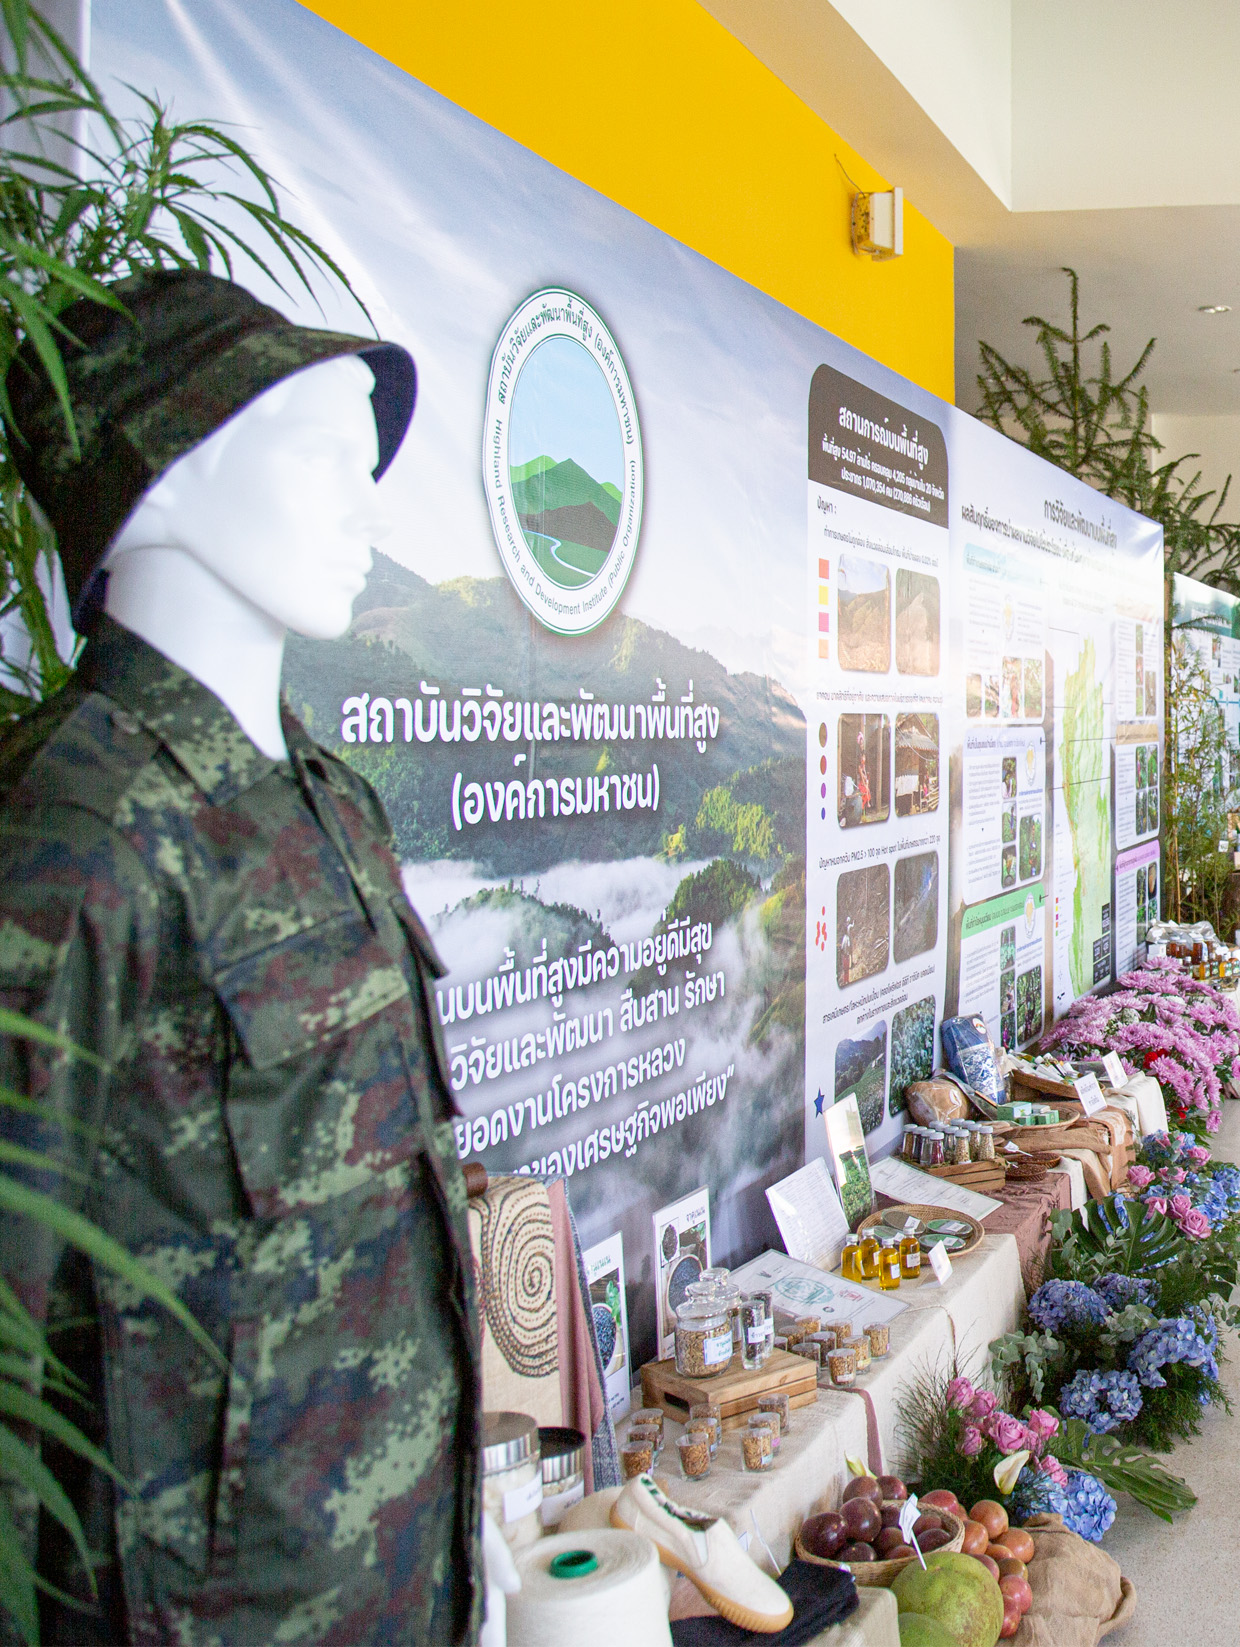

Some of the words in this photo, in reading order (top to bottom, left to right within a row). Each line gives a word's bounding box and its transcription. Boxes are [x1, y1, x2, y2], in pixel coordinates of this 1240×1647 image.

[492, 419, 503, 489] Highland
[497, 494, 522, 563] Research
[622, 460, 637, 548] Organization)
[520, 563, 535, 589] and
[534, 583, 581, 616] Development
[582, 585, 608, 614] Institute
[607, 550, 625, 589] (Public
[341, 678, 720, 753] สถาบันวิจัยและพัฒนาพื้นที่สูง
[452, 754, 660, 830] (องค์การมหาชน)
[451, 1010, 614, 1091] วิจัยและพัฒนา
[620, 987, 679, 1032] สืบสาน
[684, 970, 726, 1010] รักษา
